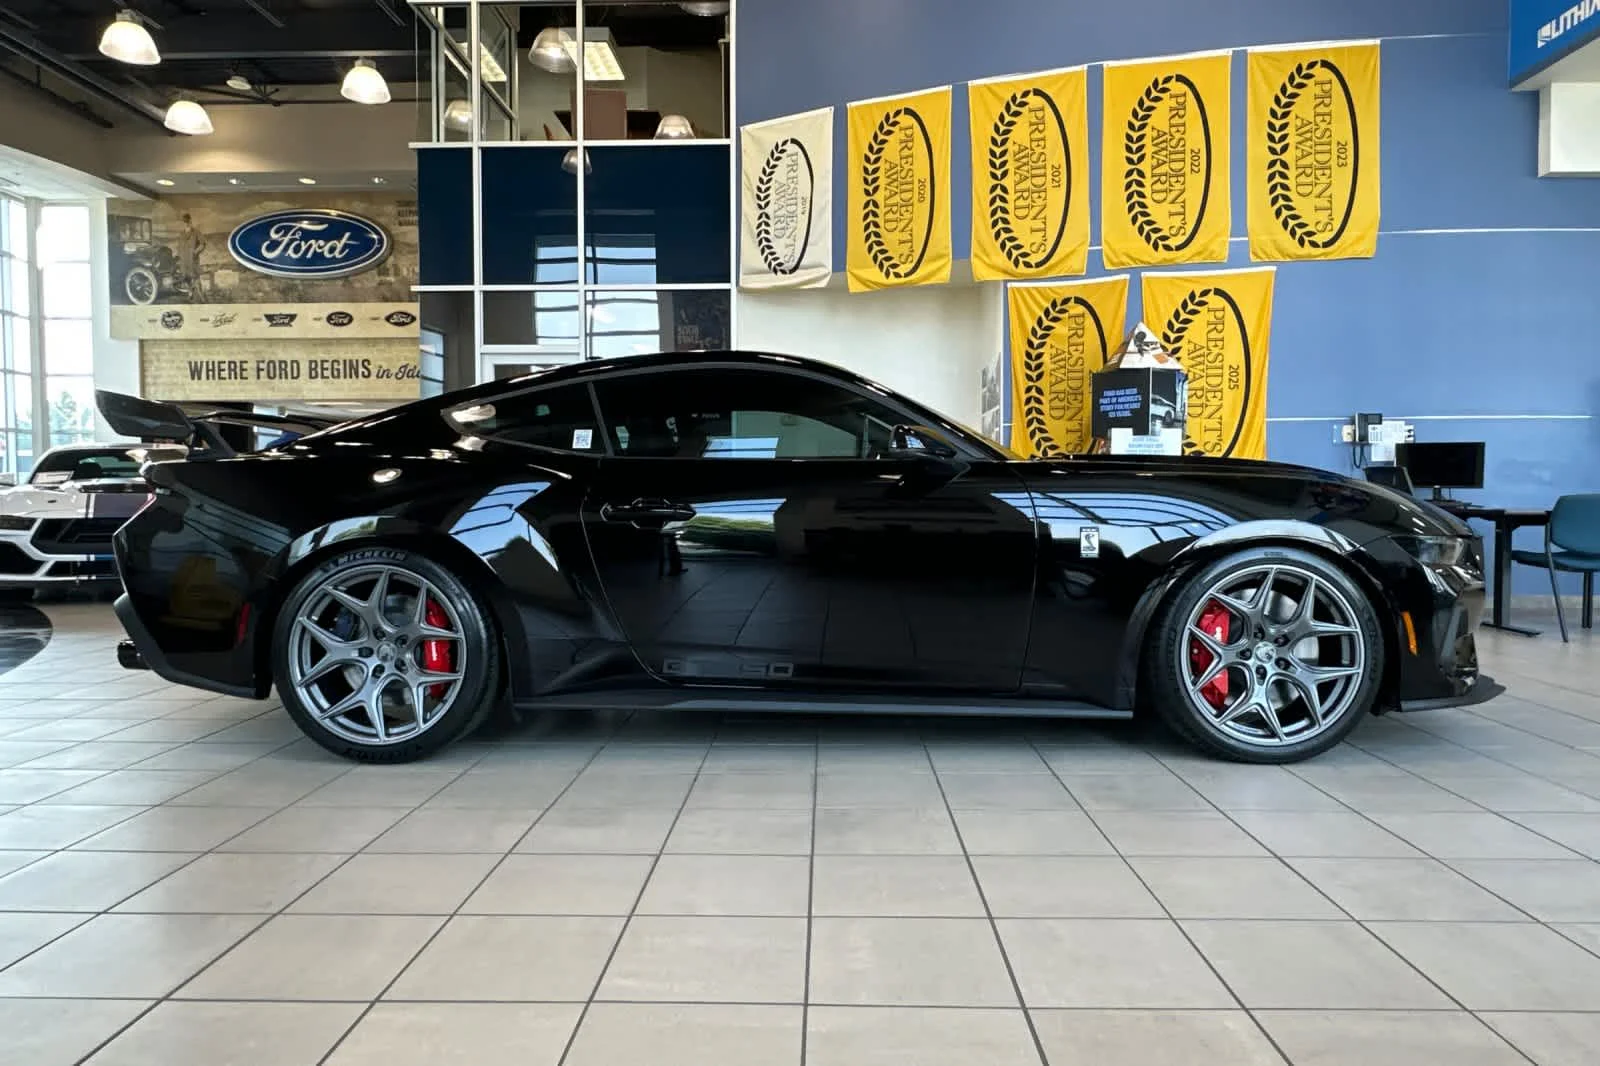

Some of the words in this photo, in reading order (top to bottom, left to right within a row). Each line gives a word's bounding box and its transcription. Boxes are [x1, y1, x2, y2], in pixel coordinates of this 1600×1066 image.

[1012, 140, 1029, 220] AWARD
[1028, 105, 1047, 254] PRESIDENT'S
[1051, 164, 1061, 188] 2021
[1151, 127, 1168, 204] AWARD
[1168, 91, 1187, 237] PRESIDENT'S
[1190, 148, 1201, 174] 2022
[1295, 115, 1314, 198] AWARD
[1313, 79, 1334, 233] PRESIDENT'S
[1336, 140, 1348, 168] 2023
[773, 179, 787, 239] AWARD
[784, 151, 799, 266] PRESIDENT'S
[883, 158, 899, 233] AWARD
[897, 123, 914, 266] PRESIDENT'S
[261, 221, 361, 260] Ford
[188, 360, 249, 381] WHERE
[255, 360, 300, 381] FORD
[308, 358, 371, 380] BEGINS
[375, 364, 393, 380] in
[1048, 344, 1067, 421] AWARD
[1066, 312, 1085, 453] PRESIDENT'S
[1187, 340, 1204, 418] AWARD
[1205, 305, 1225, 453] PRESIDENT'S
[1228, 364, 1240, 391] 2025
[338, 550, 406, 565] MICHELIN
